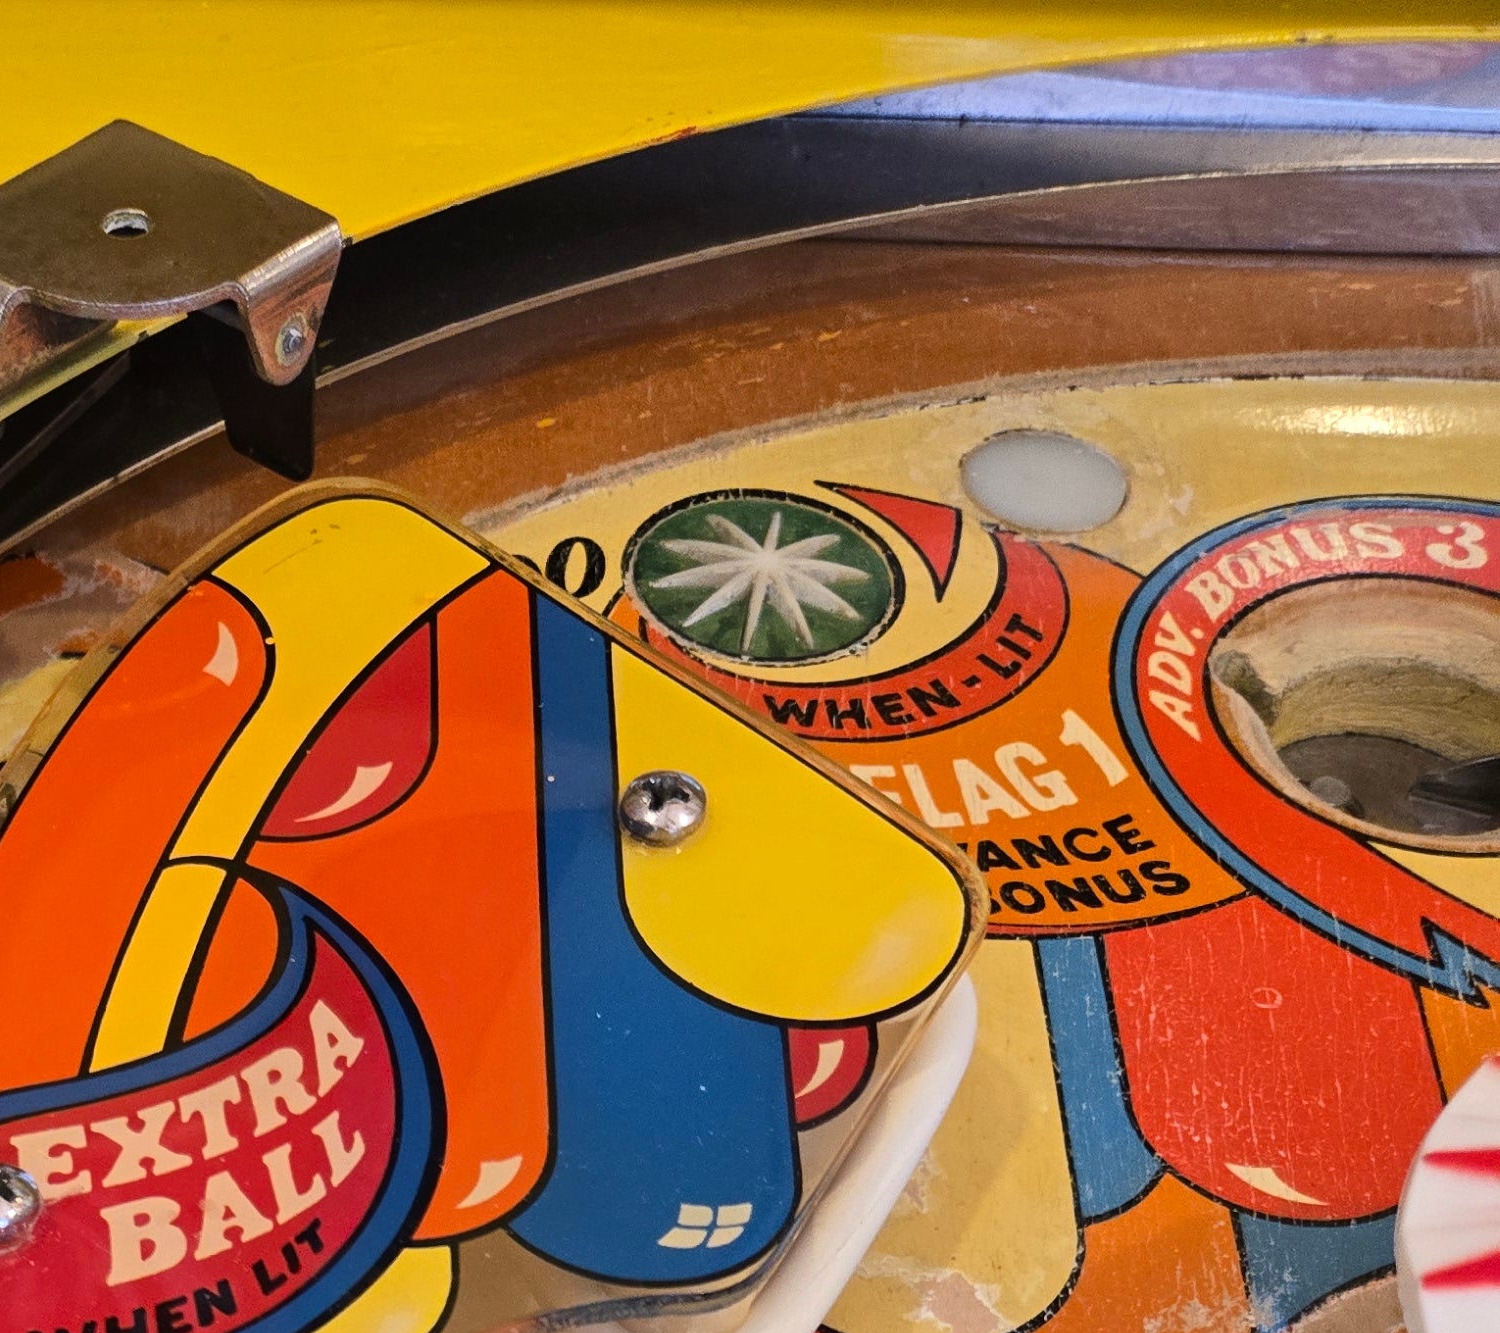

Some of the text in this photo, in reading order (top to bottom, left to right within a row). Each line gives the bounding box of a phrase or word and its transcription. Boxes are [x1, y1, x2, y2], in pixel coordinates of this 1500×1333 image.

[1147, 521, 1488, 742] ADV. BONUS 3
[957, 813, 1156, 872] ANCE
[9, 999, 365, 1202] EXTRA
[100, 1109, 366, 1288] BALL
[252, 1217, 326, 1297] LIT
